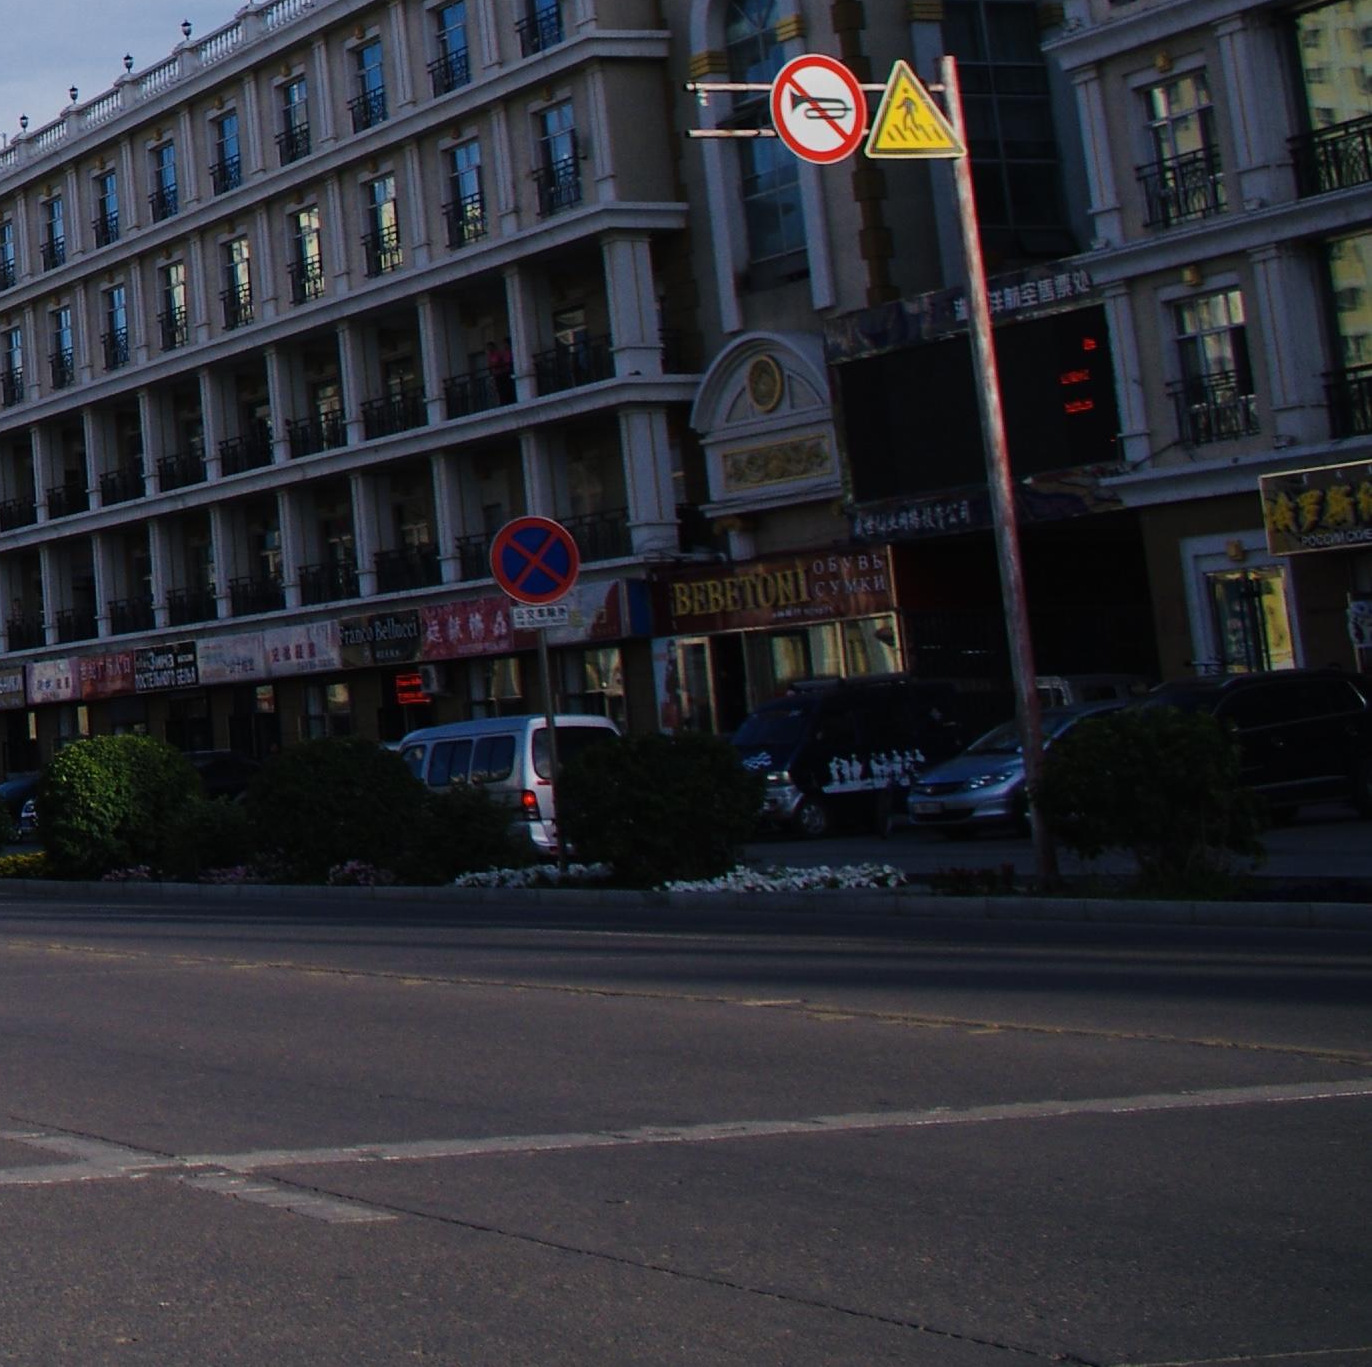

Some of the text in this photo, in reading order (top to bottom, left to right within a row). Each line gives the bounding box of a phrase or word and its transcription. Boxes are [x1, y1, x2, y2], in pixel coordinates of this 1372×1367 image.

[812, 554, 885, 575] ОБУВЬ
[673, 567, 811, 617] BEBETONI
[814, 575, 887, 597] СУМКИ
[375, 616, 418, 641] Bellucci
